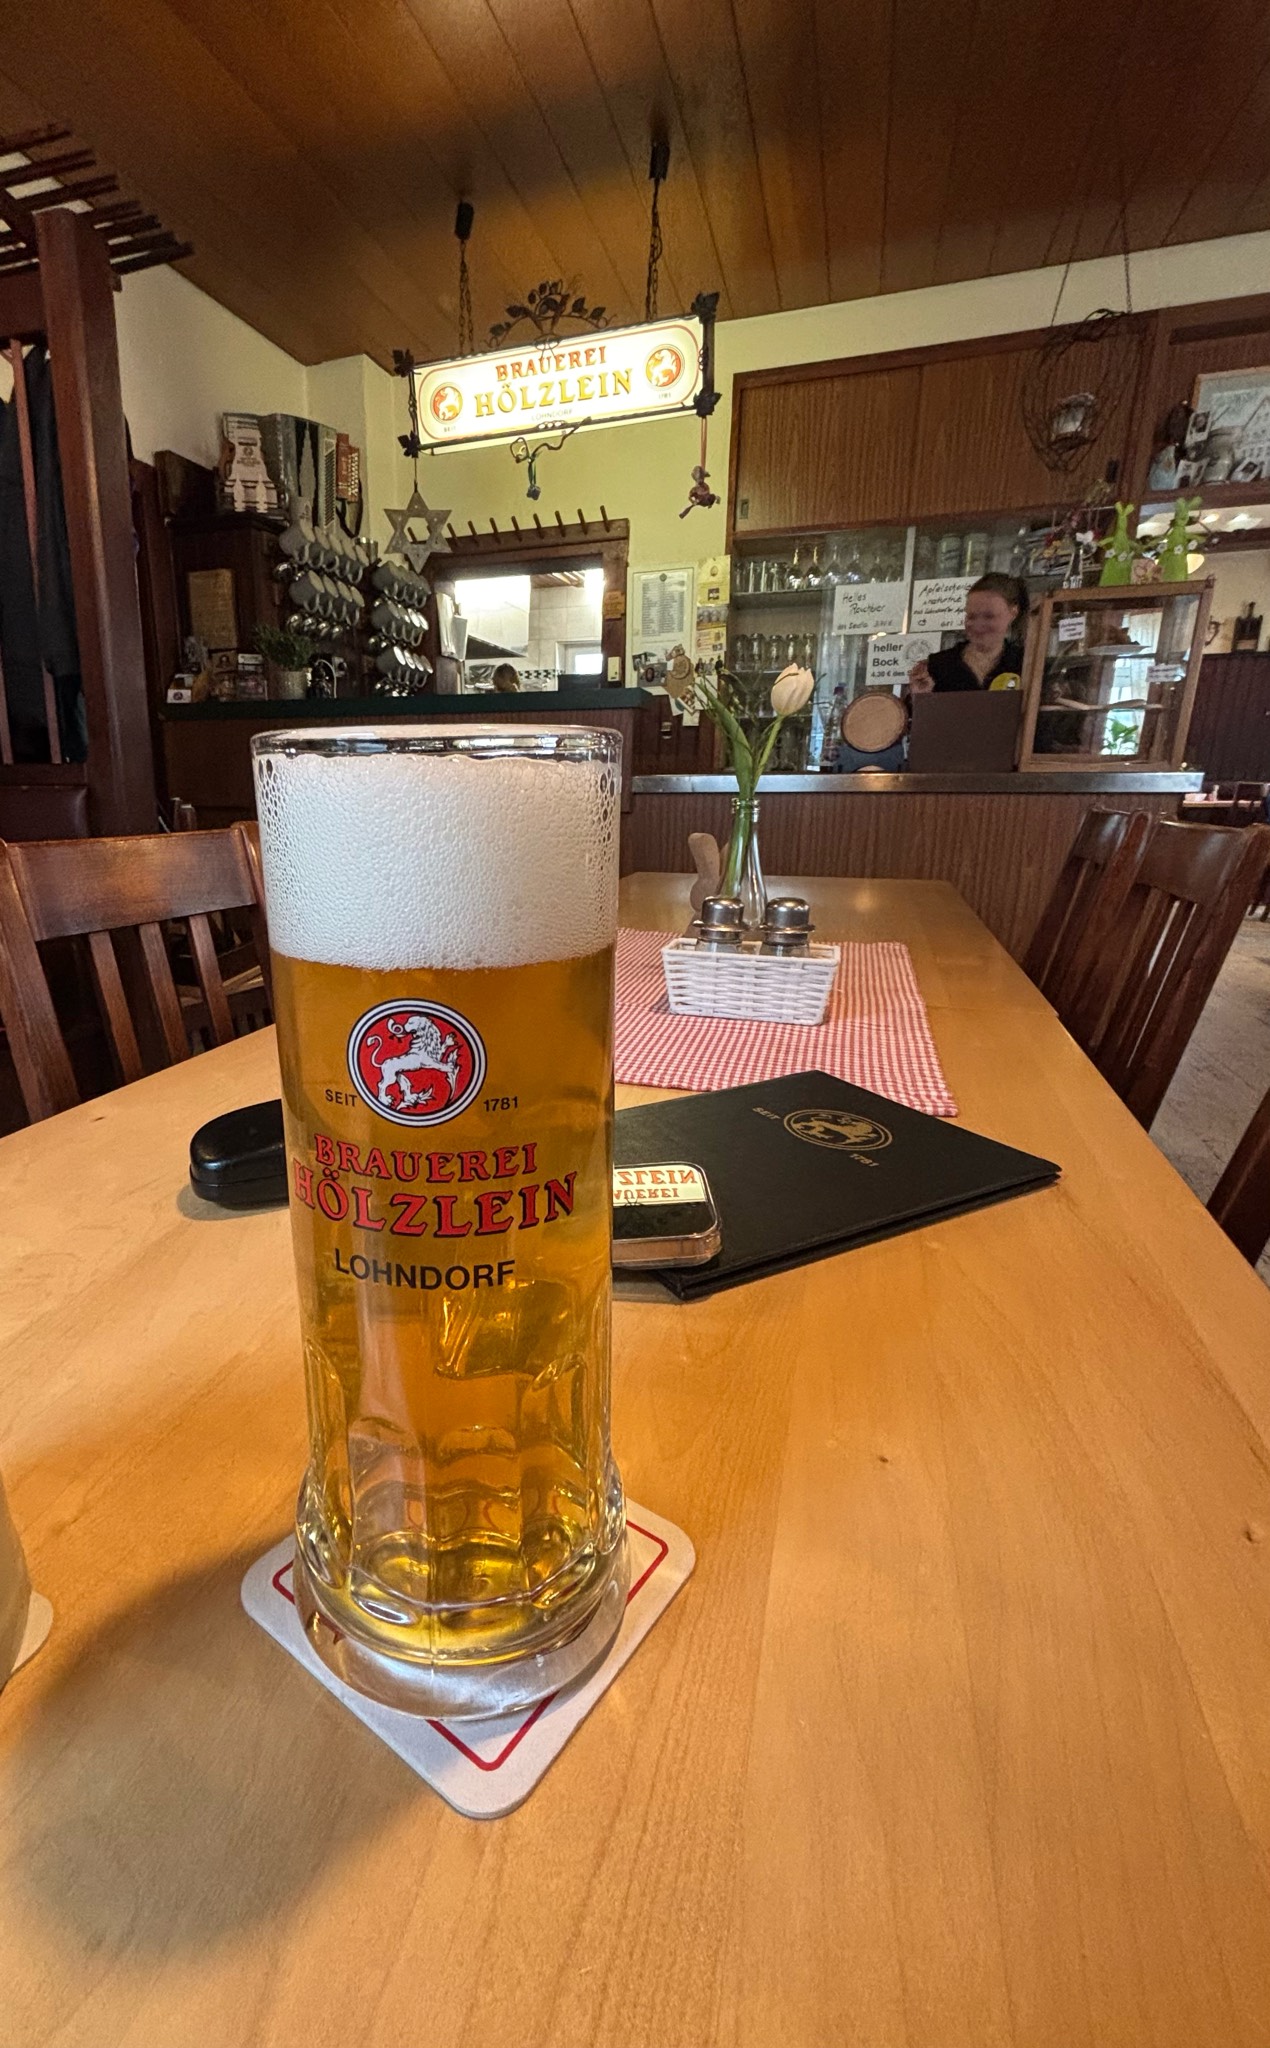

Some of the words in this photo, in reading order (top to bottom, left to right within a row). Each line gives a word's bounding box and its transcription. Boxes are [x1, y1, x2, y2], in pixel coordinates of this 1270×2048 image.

[496, 346, 607, 382] BRAUEREI
[475, 368, 633, 417] HÖLZLEIN
[531, 408, 573, 422] LOHNDORF
[872, 658, 899, 667] Bock
[873, 643, 904, 653] heller
[325, 1088, 358, 1107] SEIT
[483, 1095, 519, 1113] 1781
[752, 1107, 781, 1120] SEIT
[314, 1133, 537, 1183] BRAUEREI
[293, 1158, 578, 1238] HÖLZLEIN
[334, 1248, 516, 1290] LOHNDORF
